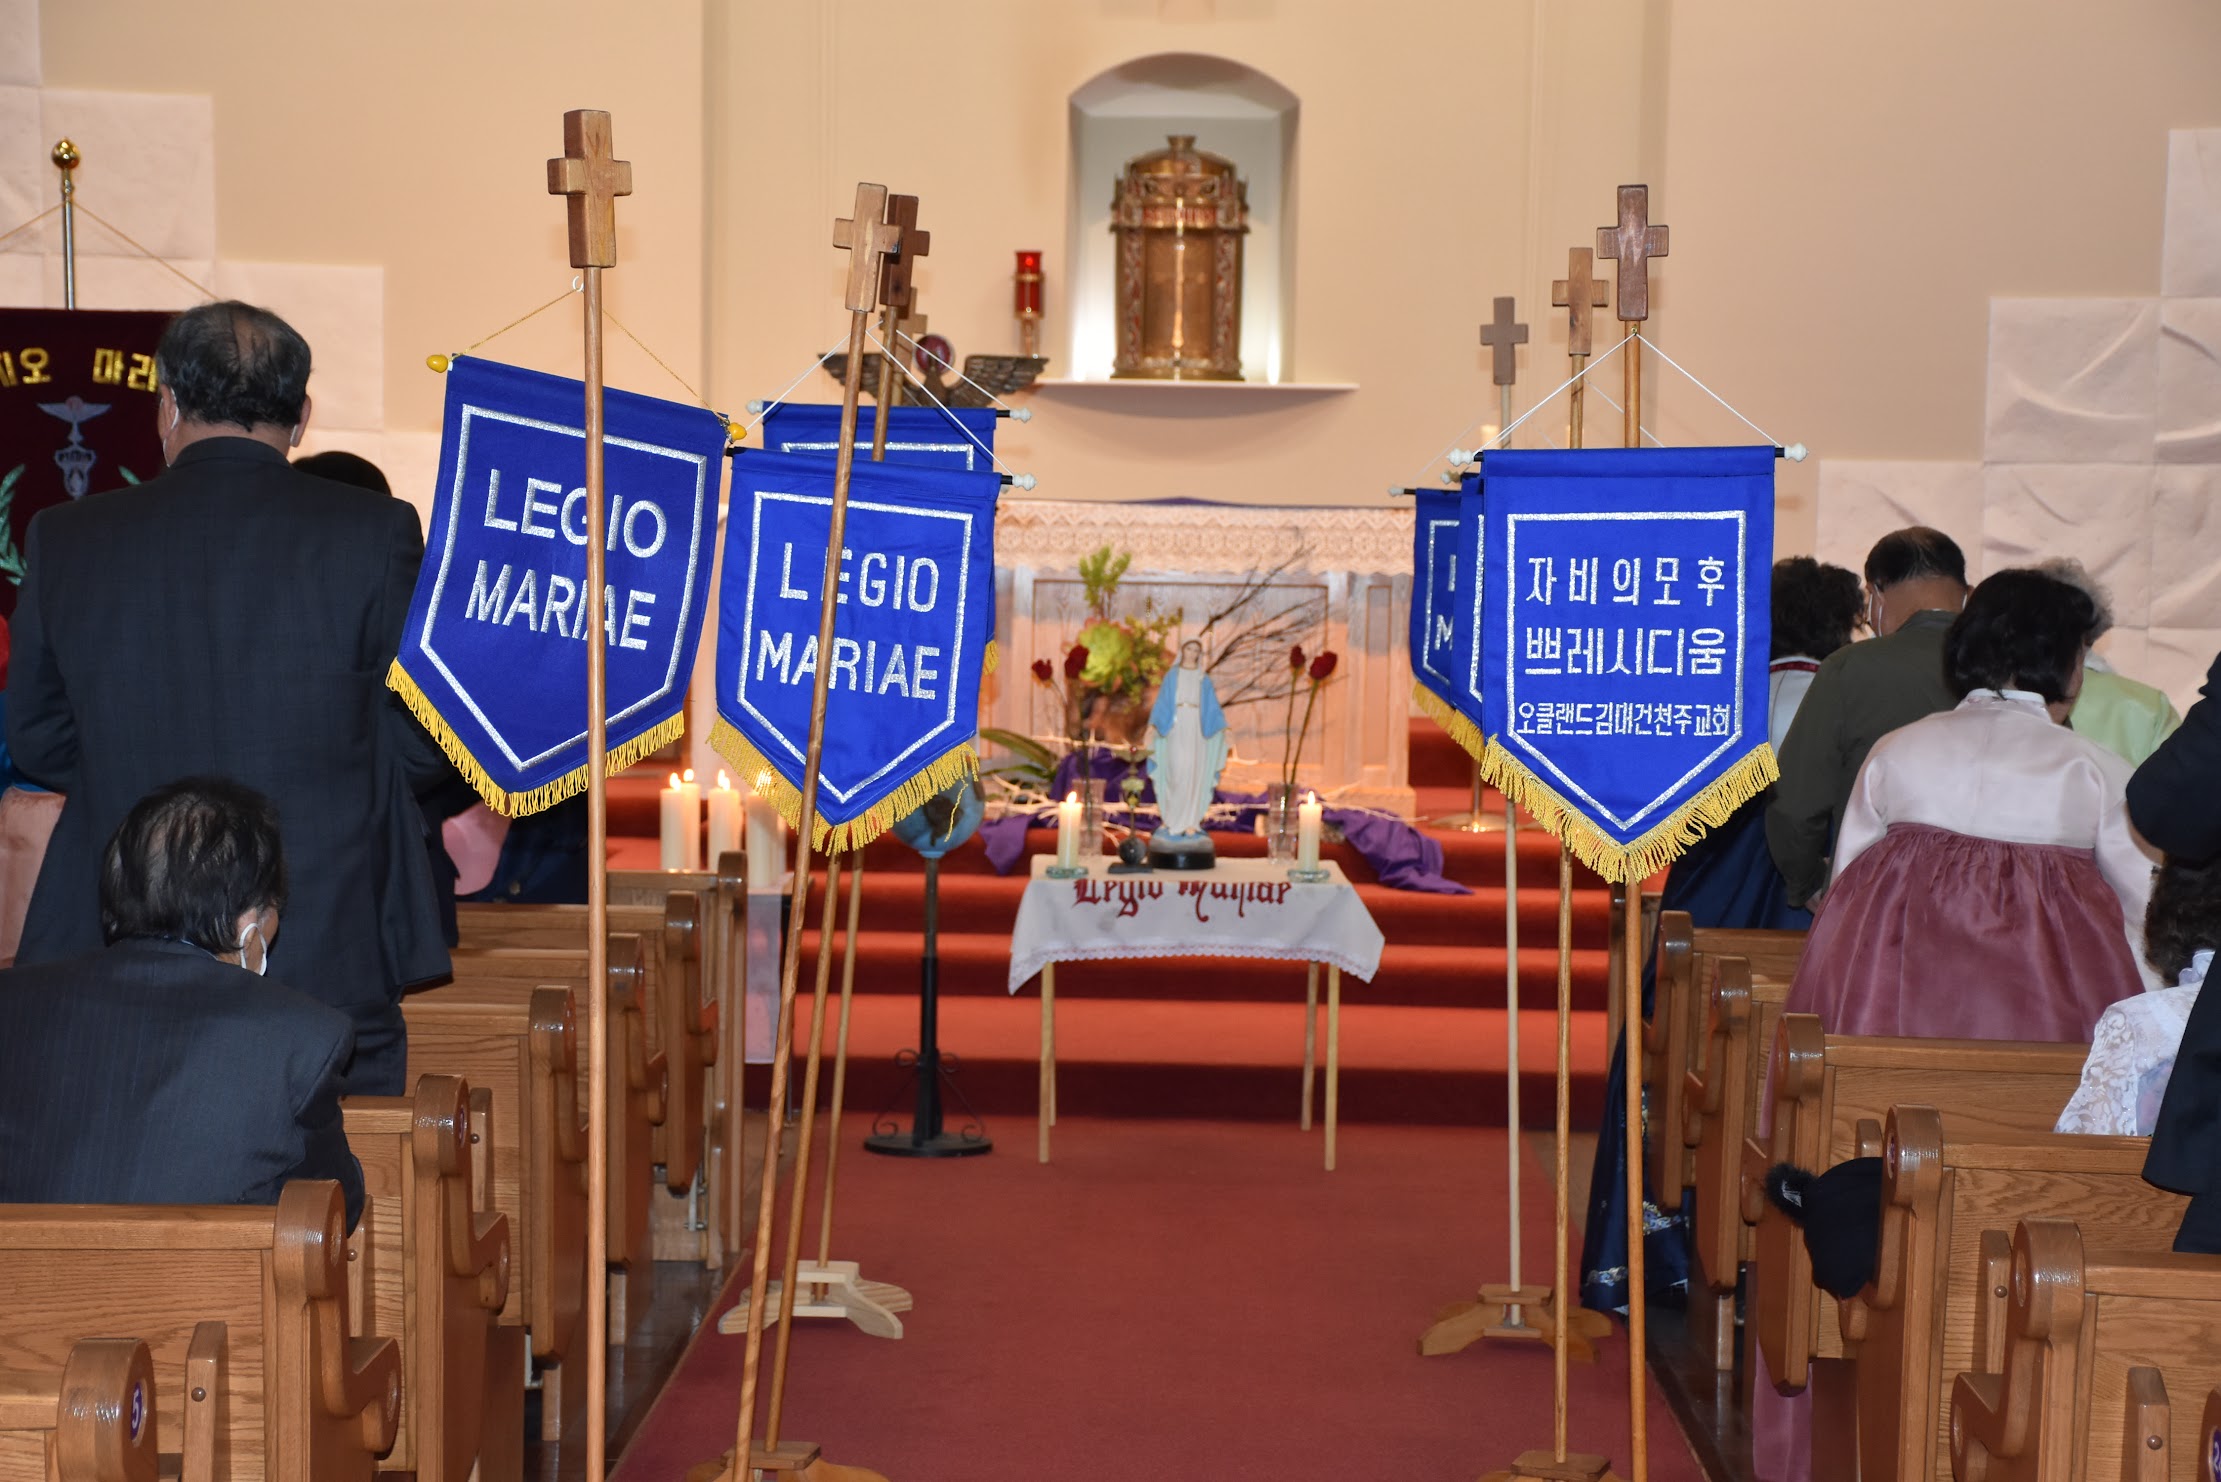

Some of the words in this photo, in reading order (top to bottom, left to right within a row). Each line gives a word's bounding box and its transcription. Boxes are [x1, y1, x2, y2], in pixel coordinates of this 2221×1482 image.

[483, 468, 668, 559] LEGIO
[464, 559, 657, 651] MARIAE
[779, 541, 940, 613] LEGIO
[755, 629, 941, 701] MARIAE
[1524, 626, 1727, 676] 쁘레시디움
